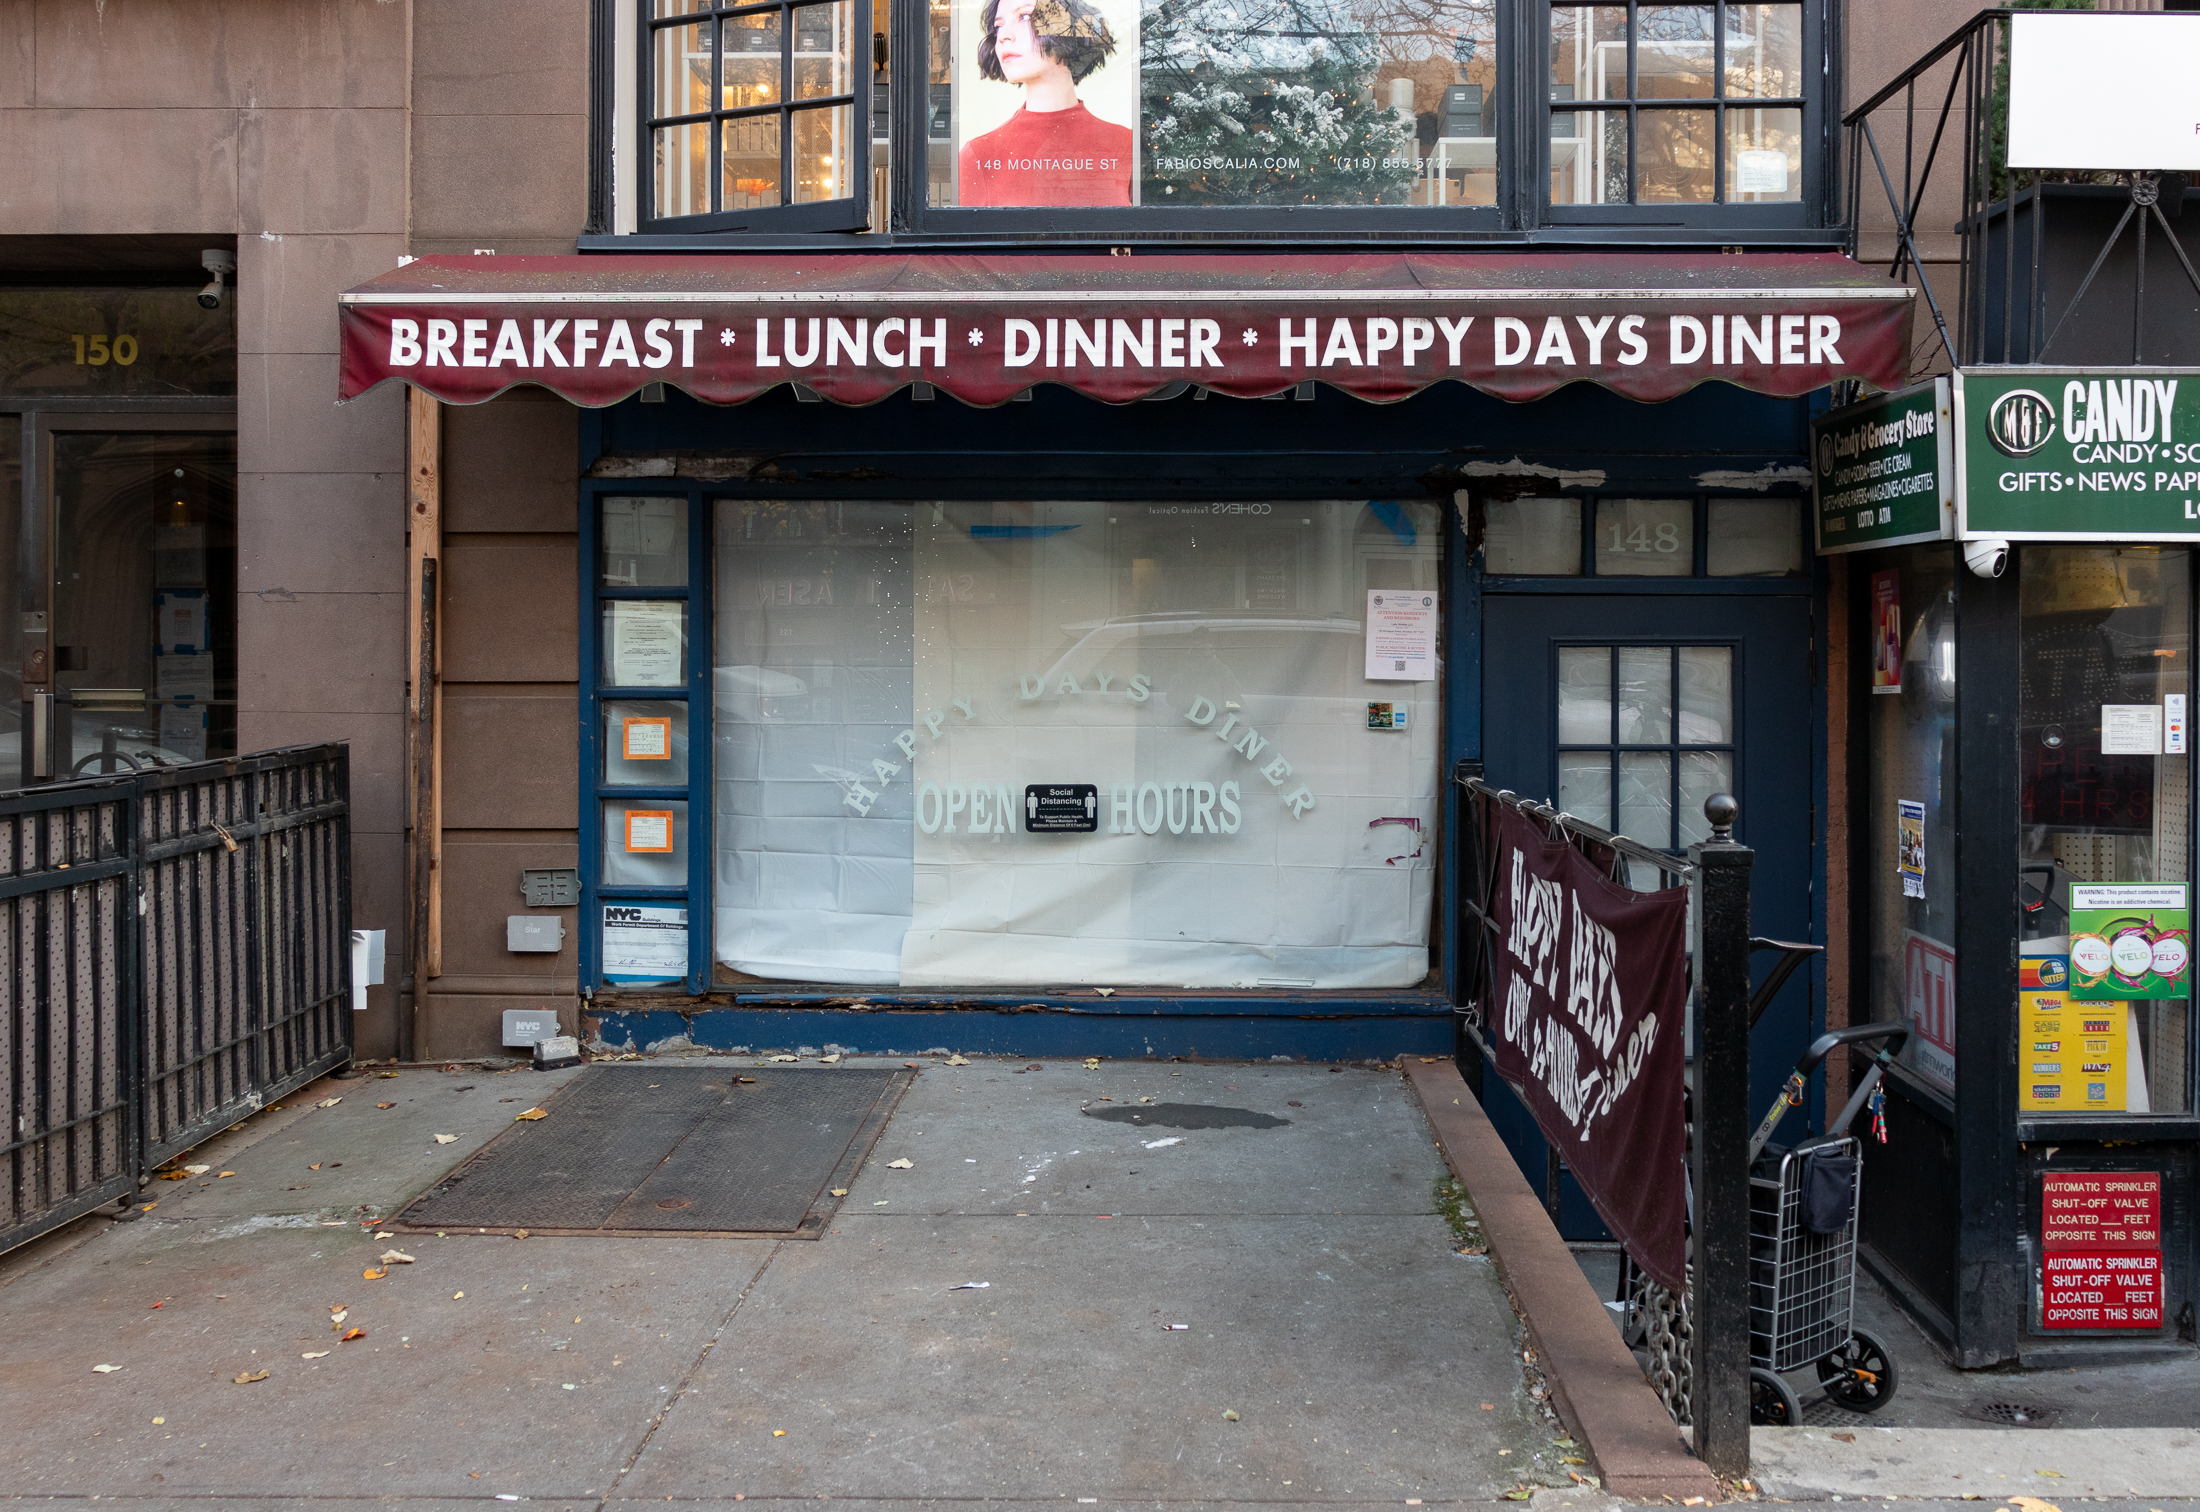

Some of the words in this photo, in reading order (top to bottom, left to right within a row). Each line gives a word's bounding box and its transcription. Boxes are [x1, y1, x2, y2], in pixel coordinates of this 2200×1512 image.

[975, 158, 1002, 171] 148
[1007, 158, 1095, 171] MONTAGUE
[1099, 158, 1119, 171] ST
[1156, 157, 1300, 170] FABIOSCALIA.COM
[1337, 156, 1376, 171] (718)
[1382, 157, 1409, 170] 855
[389, 317, 703, 370] BREAKFAST
[755, 317, 947, 368] LUNCH
[1004, 318, 1225, 369] DINNER
[1279, 316, 1475, 368] HAPPY
[1494, 314, 1649, 366] DAYS
[1669, 314, 1845, 366] DINER
[71, 334, 139, 366] 150
[2063, 379, 2178, 443] CANDY
[1834, 427, 1860, 459] Candy
[1867, 419, 1905, 449] Grocery
[1905, 409, 1934, 439] Store
[2072, 443, 2158, 464] CANDY
[1835, 467, 1852, 486] CANDY
[1852, 463, 1868, 482] SODA
[1869, 460, 1881, 478] BEER
[1882, 457, 1891, 475] ICE
[1892, 452, 1912, 473] CREAM
[1998, 472, 2062, 492] GIFTS
[2078, 472, 2147, 492] NEWS
[1823, 494, 1835, 512] GIFTS
[1836, 491, 1850, 509] NEWS
[1850, 487, 1867, 506] PAPERS
[1869, 479, 1899, 502] MAGAZINES
[1901, 472, 1934, 496] CIGARETTES
[2184, 499, 2200, 519] L
[1857, 509, 1874, 528] LOTTO
[1878, 506, 1892, 524] ATM
[1608, 522, 1680, 553] 148
[842, 692, 978, 818] HAPPY
[1019, 671, 1152, 702] DAYS
[1184, 693, 1316, 820] DINER
[1049, 788, 1073, 796] Social
[915, 780, 1017, 835] OPEN
[1108, 780, 1242, 835] HOURS
[1041, 797, 1082, 806] Distancing
[605, 907, 642, 921] NYC
[525, 926, 541, 934] Star
[1507, 846, 1563, 1002] HAPPY
[1567, 888, 1624, 1061] DAYS
[2079, 953, 2109, 961] VELO
[2118, 951, 2148, 961] VELO
[2042, 998, 2062, 1006] MEGA
[1504, 968, 1533, 1058] OPEN
[515, 1021, 541, 1031] NYC
[2051, 1042, 2059, 1051] 5
[2033, 1064, 2061, 1072] NUMBERS
[1575, 1011, 1660, 1142] Diner
[2044, 1182, 2101, 1192] AUTOMATIC
[2105, 1182, 2157, 1192] SPRINKLER
[2052, 1198, 2107, 1208] SHUT-OFF
[2114, 1198, 2149, 1208] VALVE
[2049, 1215, 2099, 1225] LOCATED
[2123, 1215, 2151, 1225] FEET
[2045, 1231, 2097, 1241] OPPOSITE
[2103, 1231, 2126, 1241] THIS
[2132, 1231, 2155, 1241] SIGN
[2047, 1258, 2103, 1270] AUTOMATIC
[2105, 1258, 2157, 1270] SPRINKLER
[2052, 1274, 2111, 1287] SHUT-OFF
[2116, 1274, 2153, 1287] VALVE
[2050, 1291, 2103, 1303] LOCATED
[2125, 1291, 2154, 1303] FEET
[2048, 1308, 2100, 1321] OPPOSITE
[2104, 1308, 2128, 1321] THIS
[2132, 1308, 2158, 1321] SIGN
